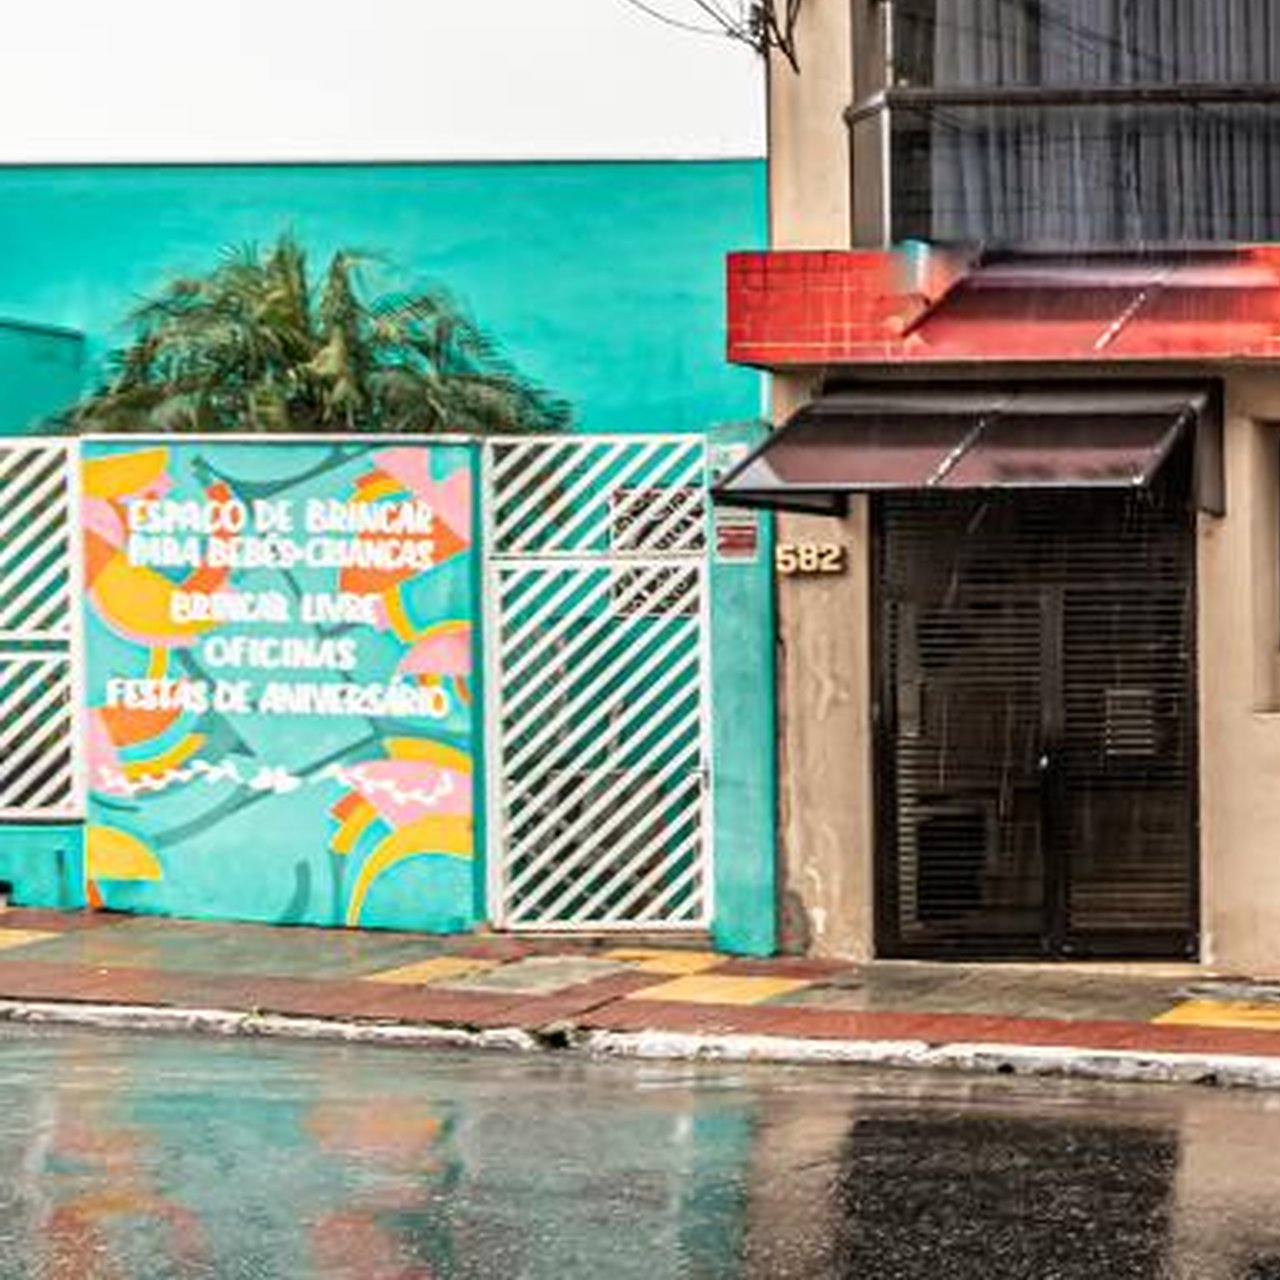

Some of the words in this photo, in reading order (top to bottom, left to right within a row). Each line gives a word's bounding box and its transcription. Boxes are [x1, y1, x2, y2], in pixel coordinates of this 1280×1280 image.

[253, 499, 293, 532] DE
[305, 499, 434, 533] BRINCAR
[127, 534, 201, 566] PARA
[776, 543, 843, 572] 582
[172, 592, 289, 622] BRINCAR
[301, 593, 381, 623] LIVRE
[204, 636, 357, 669] OFICINAS
[106, 678, 209, 713] FESTAS
[212, 680, 252, 713] DE
